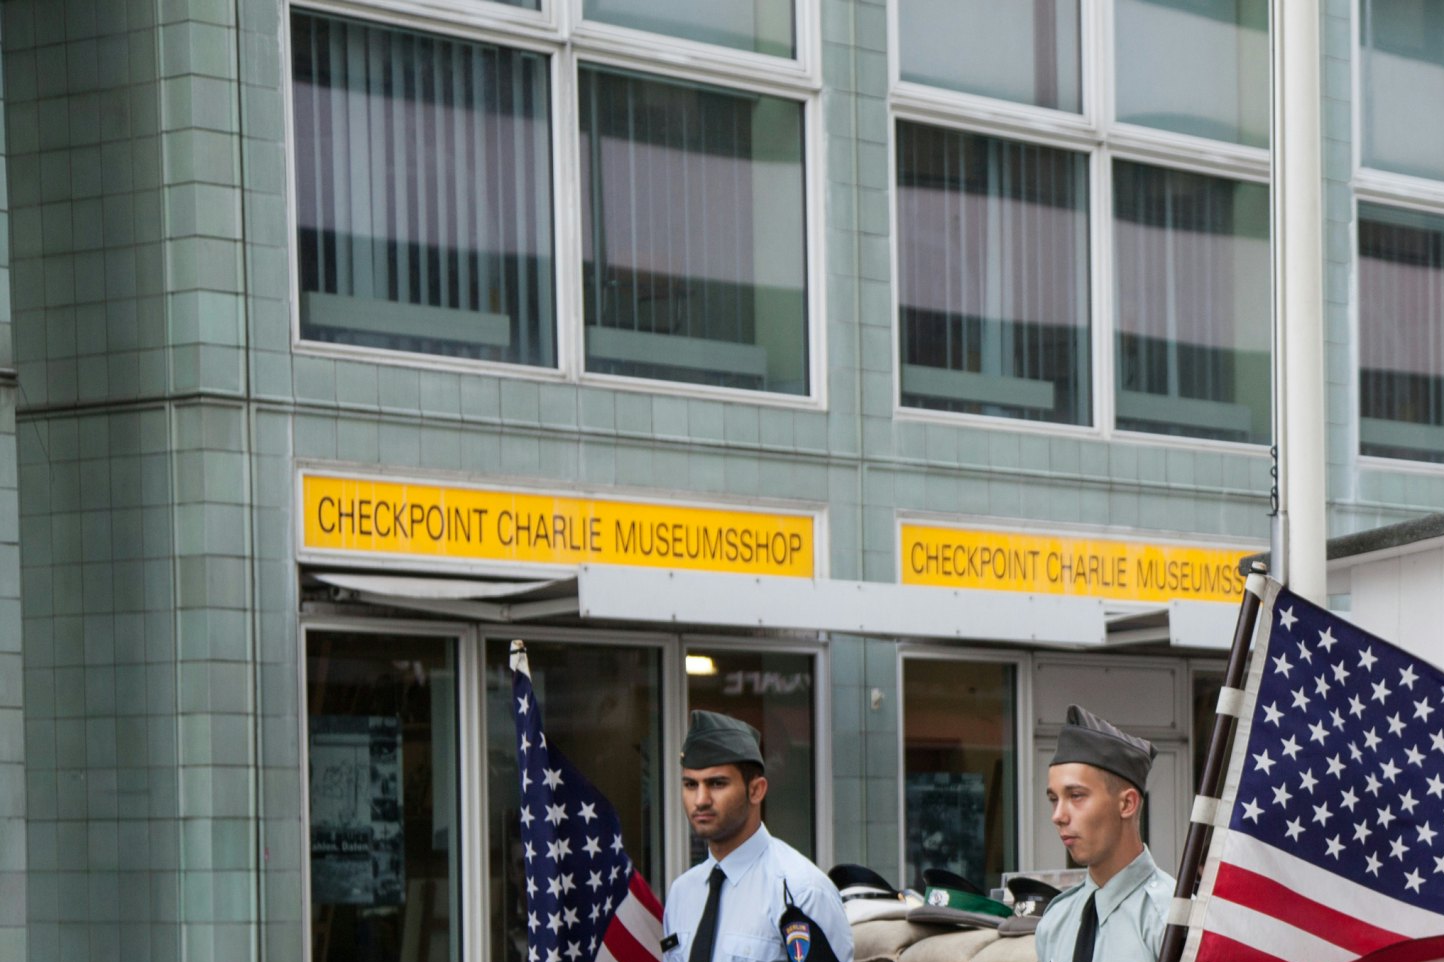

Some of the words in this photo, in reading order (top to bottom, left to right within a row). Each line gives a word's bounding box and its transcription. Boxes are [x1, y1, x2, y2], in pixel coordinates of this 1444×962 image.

[318, 496, 488, 544] CHECKPOINT
[497, 509, 602, 553] CHARLIE
[615, 520, 803, 566] MUSEUMSSHOP
[911, 541, 1041, 582] CHECKPOINT
[1046, 551, 1128, 588] CHARLIE
